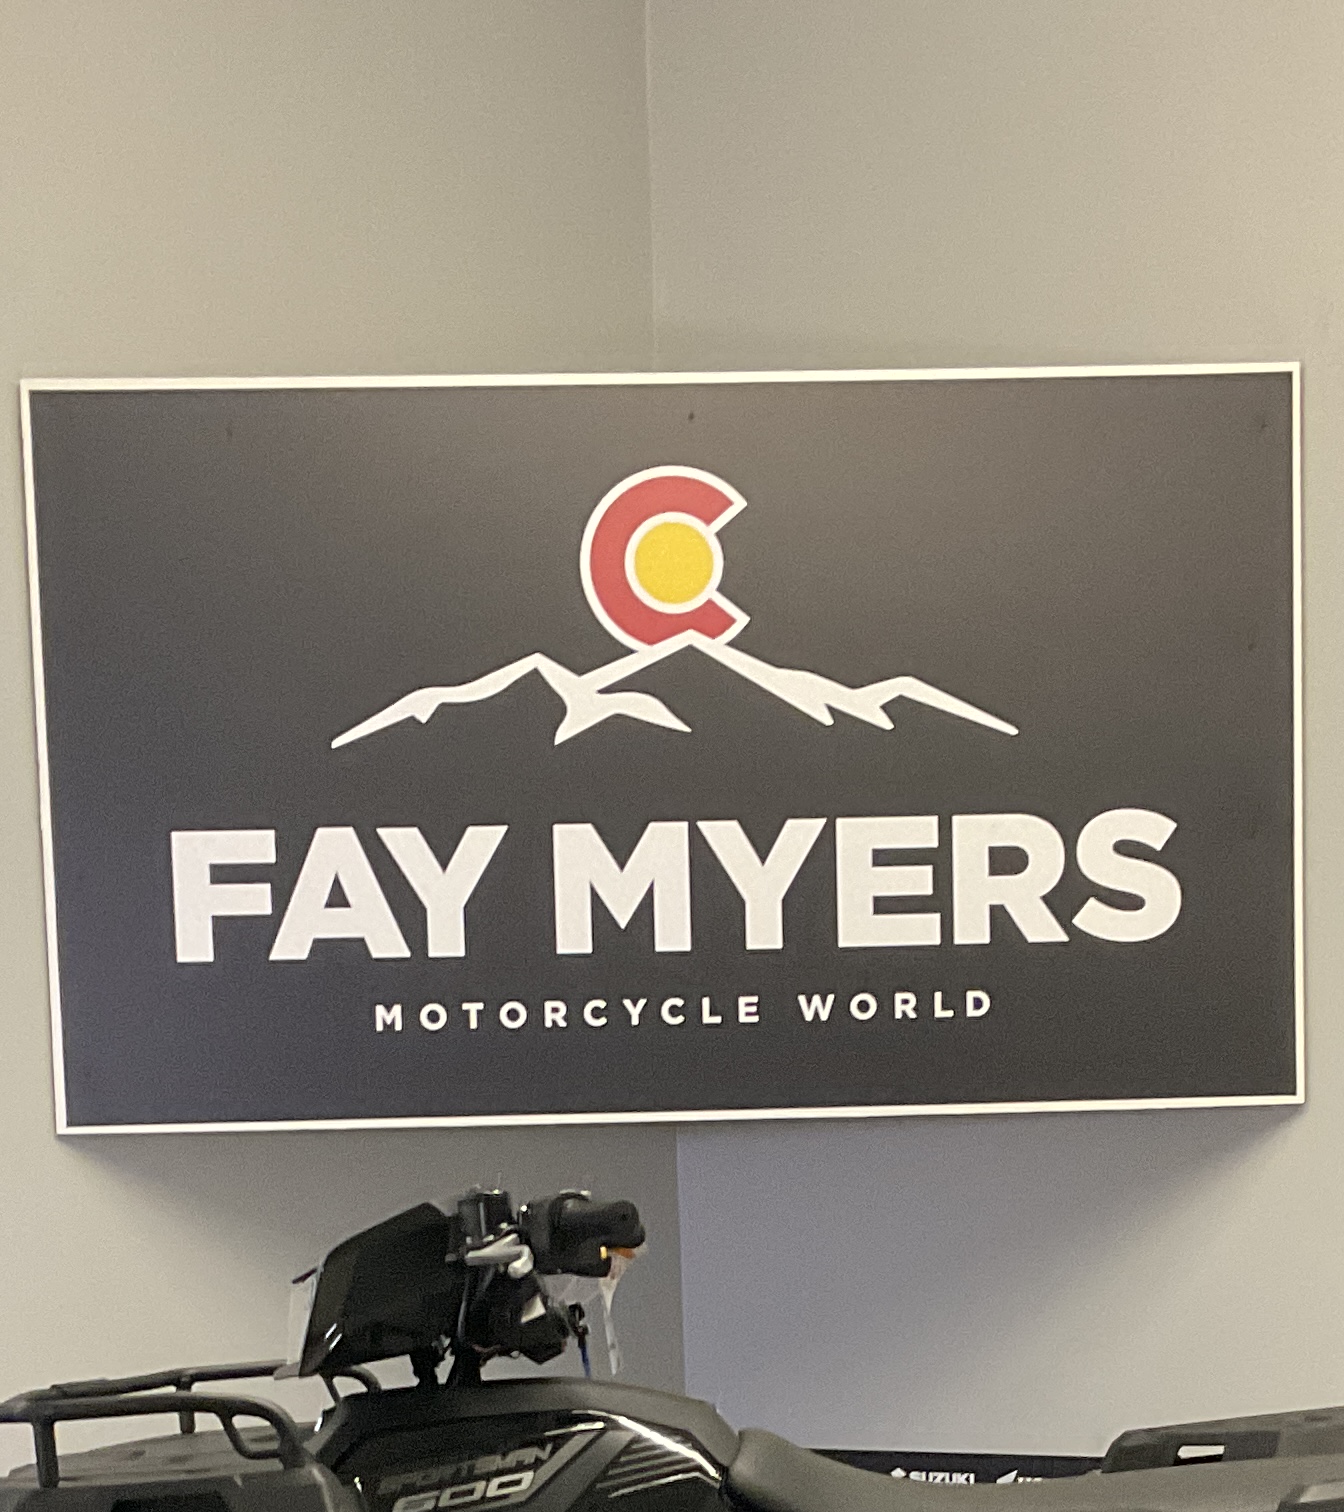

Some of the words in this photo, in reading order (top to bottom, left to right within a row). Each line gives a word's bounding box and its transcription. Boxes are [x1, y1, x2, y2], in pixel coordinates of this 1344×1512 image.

[171, 825, 507, 962] FAY
[553, 809, 1181, 954] MYERS
[376, 996, 759, 1031] MOTORCYCLE
[798, 991, 990, 1021] WORLD
[909, 1471, 975, 1485] SUZUKI
